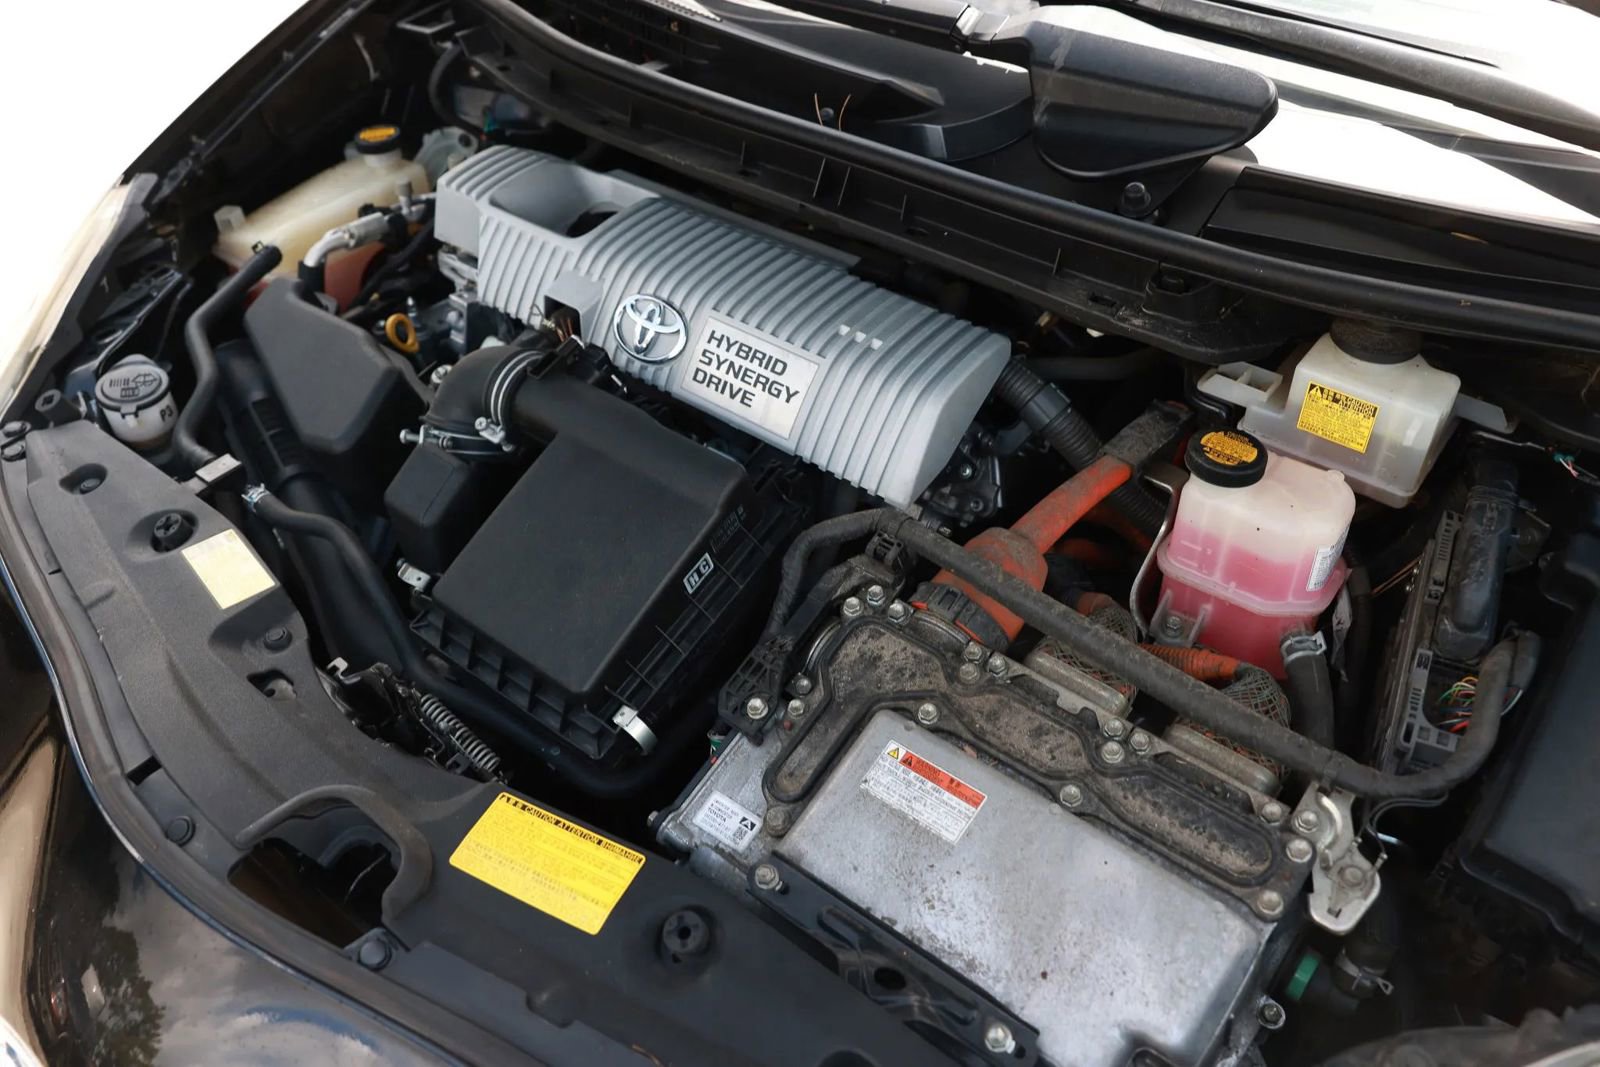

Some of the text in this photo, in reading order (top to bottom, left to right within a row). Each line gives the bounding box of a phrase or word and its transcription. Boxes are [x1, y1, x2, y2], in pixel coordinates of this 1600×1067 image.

[707, 330, 788, 376] HYBRID
[692, 367, 756, 408] DRIVE
[699, 349, 800, 404] SYNERGY
[525, 807, 557, 826] CAUTION
[557, 821, 598, 844] ATTENTION
